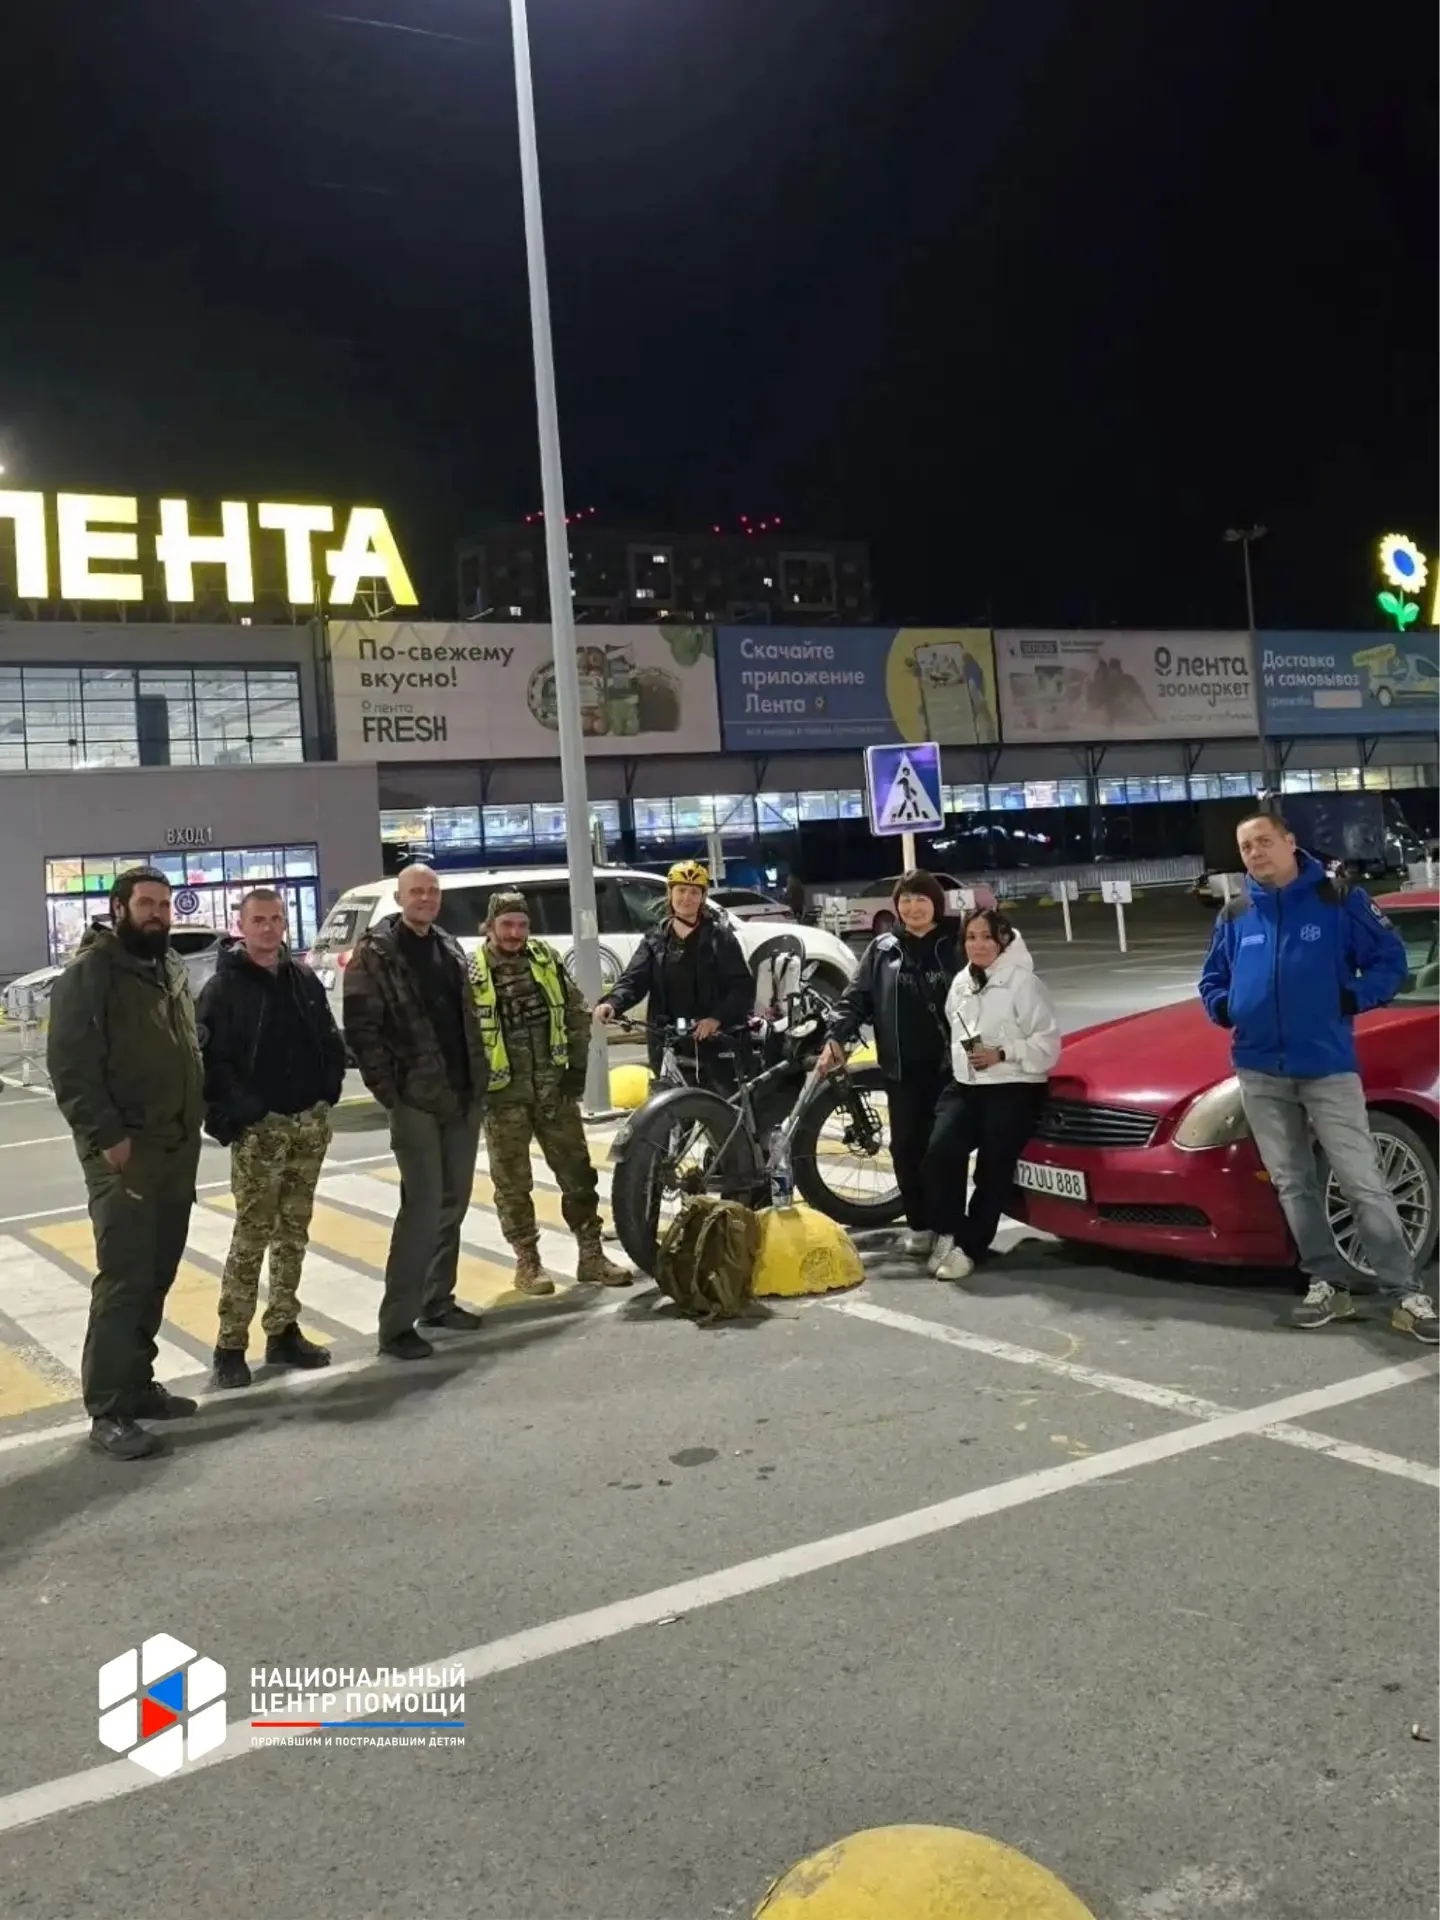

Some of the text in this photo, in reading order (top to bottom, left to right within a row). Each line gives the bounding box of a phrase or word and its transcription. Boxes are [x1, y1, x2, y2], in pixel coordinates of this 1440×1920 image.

[358, 639, 515, 667] По-свежему
[740, 638, 835, 660] Скачайте
[1263, 648, 1335, 671] Доставка
[1176, 655, 1249, 677] лента
[361, 666, 458, 693] вкусно!
[741, 669, 865, 690] приложение
[1264, 674, 1360, 687] и самовывоз
[744, 693, 806, 714] Лента
[1158, 681, 1251, 707] зоомаркет
[374, 703, 414, 714] лента
[362, 715, 448, 743] FRESH
[167, 828, 205, 845] ВХОД
[1056, 1172, 1082, 1196] 888
